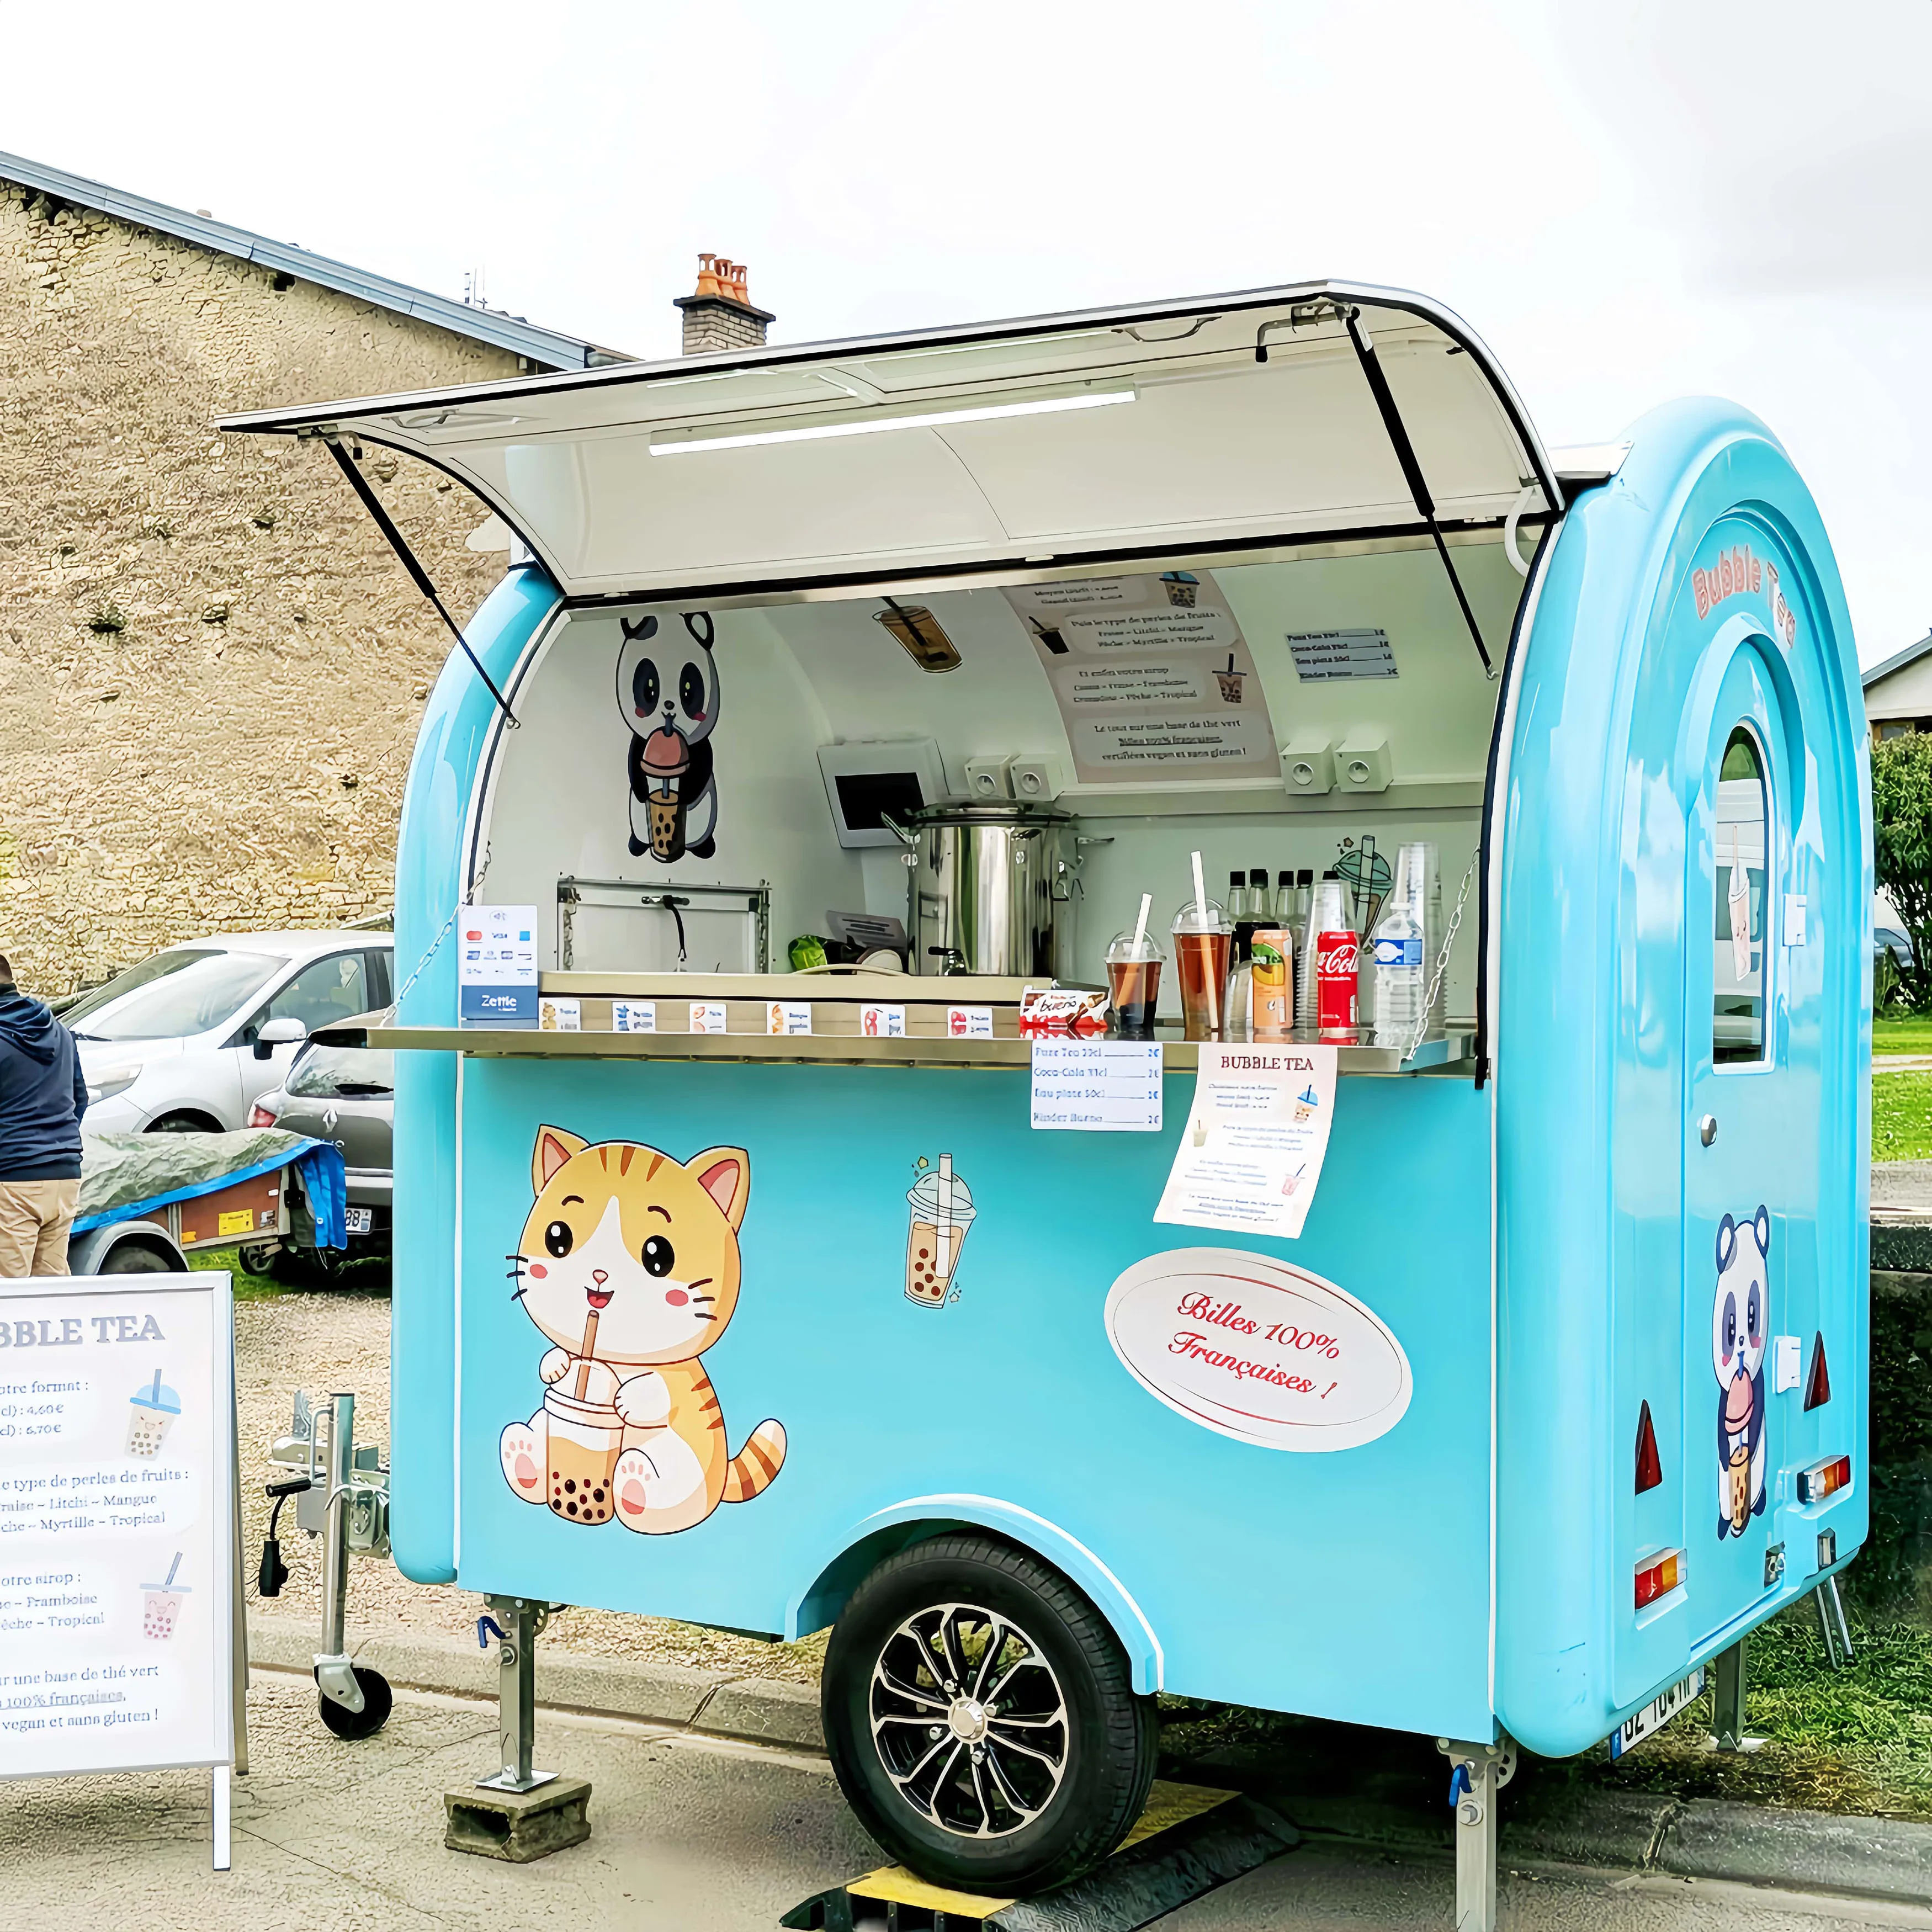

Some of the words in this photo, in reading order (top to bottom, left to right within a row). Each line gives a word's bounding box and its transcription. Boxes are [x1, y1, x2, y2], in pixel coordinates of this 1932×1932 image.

[1692, 545, 1761, 620] Bubble
[1034, 1068, 1084, 1077] Coca-Cola
[1221, 1056, 1280, 1069] BUBBLE
[1284, 1058, 1314, 1070] TEA
[91, 1314, 166, 1344] TEA
[1177, 1292, 1261, 1334] Billes
[1264, 1323, 1339, 1359] 100%
[1168, 1331, 1317, 1393] Françaises
[14, 1479, 46, 1492] type
[51, 1474, 67, 1487] de
[72, 1472, 116, 1489] perles
[120, 1471, 137, 1483] de
[141, 1468, 182, 1482] fruits
[50, 1496, 88, 1510] Litchi
[104, 1495, 157, 1508] Mangue
[40, 1516, 94, 1532] Myrtille
[110, 1511, 165, 1527] Tropical
[36, 1572, 73, 1586] sirop
[27, 1593, 98, 1608] Framboise
[48, 1612, 105, 1628] Tropical
[14, 1674, 40, 1685] une
[45, 1670, 77, 1682] base
[81, 1667, 98, 1680] de
[103, 1665, 126, 1679] thé
[130, 1666, 159, 1676] vert
[7, 1694, 46, 1708] 100%
[2, 1718, 45, 1732] vegan
[49, 1716, 63, 1727] et
[67, 1715, 100, 1726] sans
[104, 1710, 150, 1727] gluten
